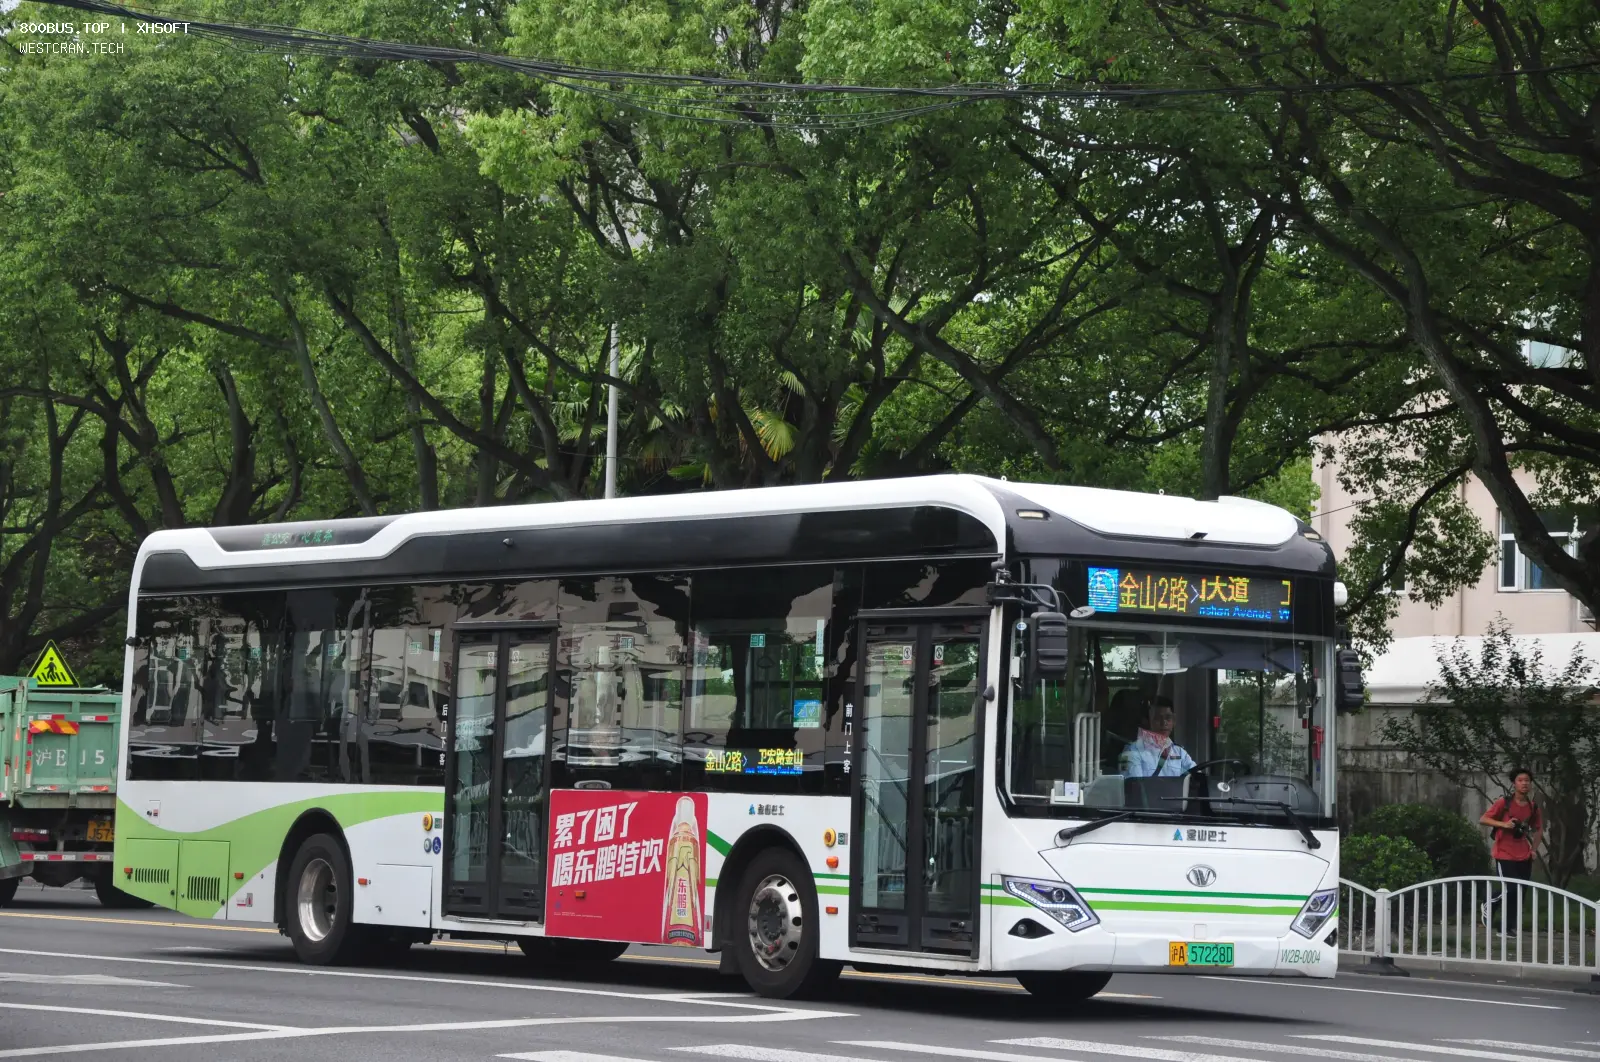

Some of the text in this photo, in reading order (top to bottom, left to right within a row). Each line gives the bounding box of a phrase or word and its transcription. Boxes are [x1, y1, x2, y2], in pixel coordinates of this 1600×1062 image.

[1119, 572, 1189, 613] 金山2路
[1232, 605, 1272, 620] Avenue
[439, 703, 448, 766] 后门下客
[843, 702, 853, 774] 前门上客
[704, 749, 742, 773] 金山2路
[553, 801, 638, 849] 累了困了
[1186, 829, 1227, 843] 金山巴士
[551, 837, 664, 887] 喝东鹏特饮
[1171, 944, 1233, 963] 沪A 57228D
[1281, 949, 1321, 964] W2B-0004
